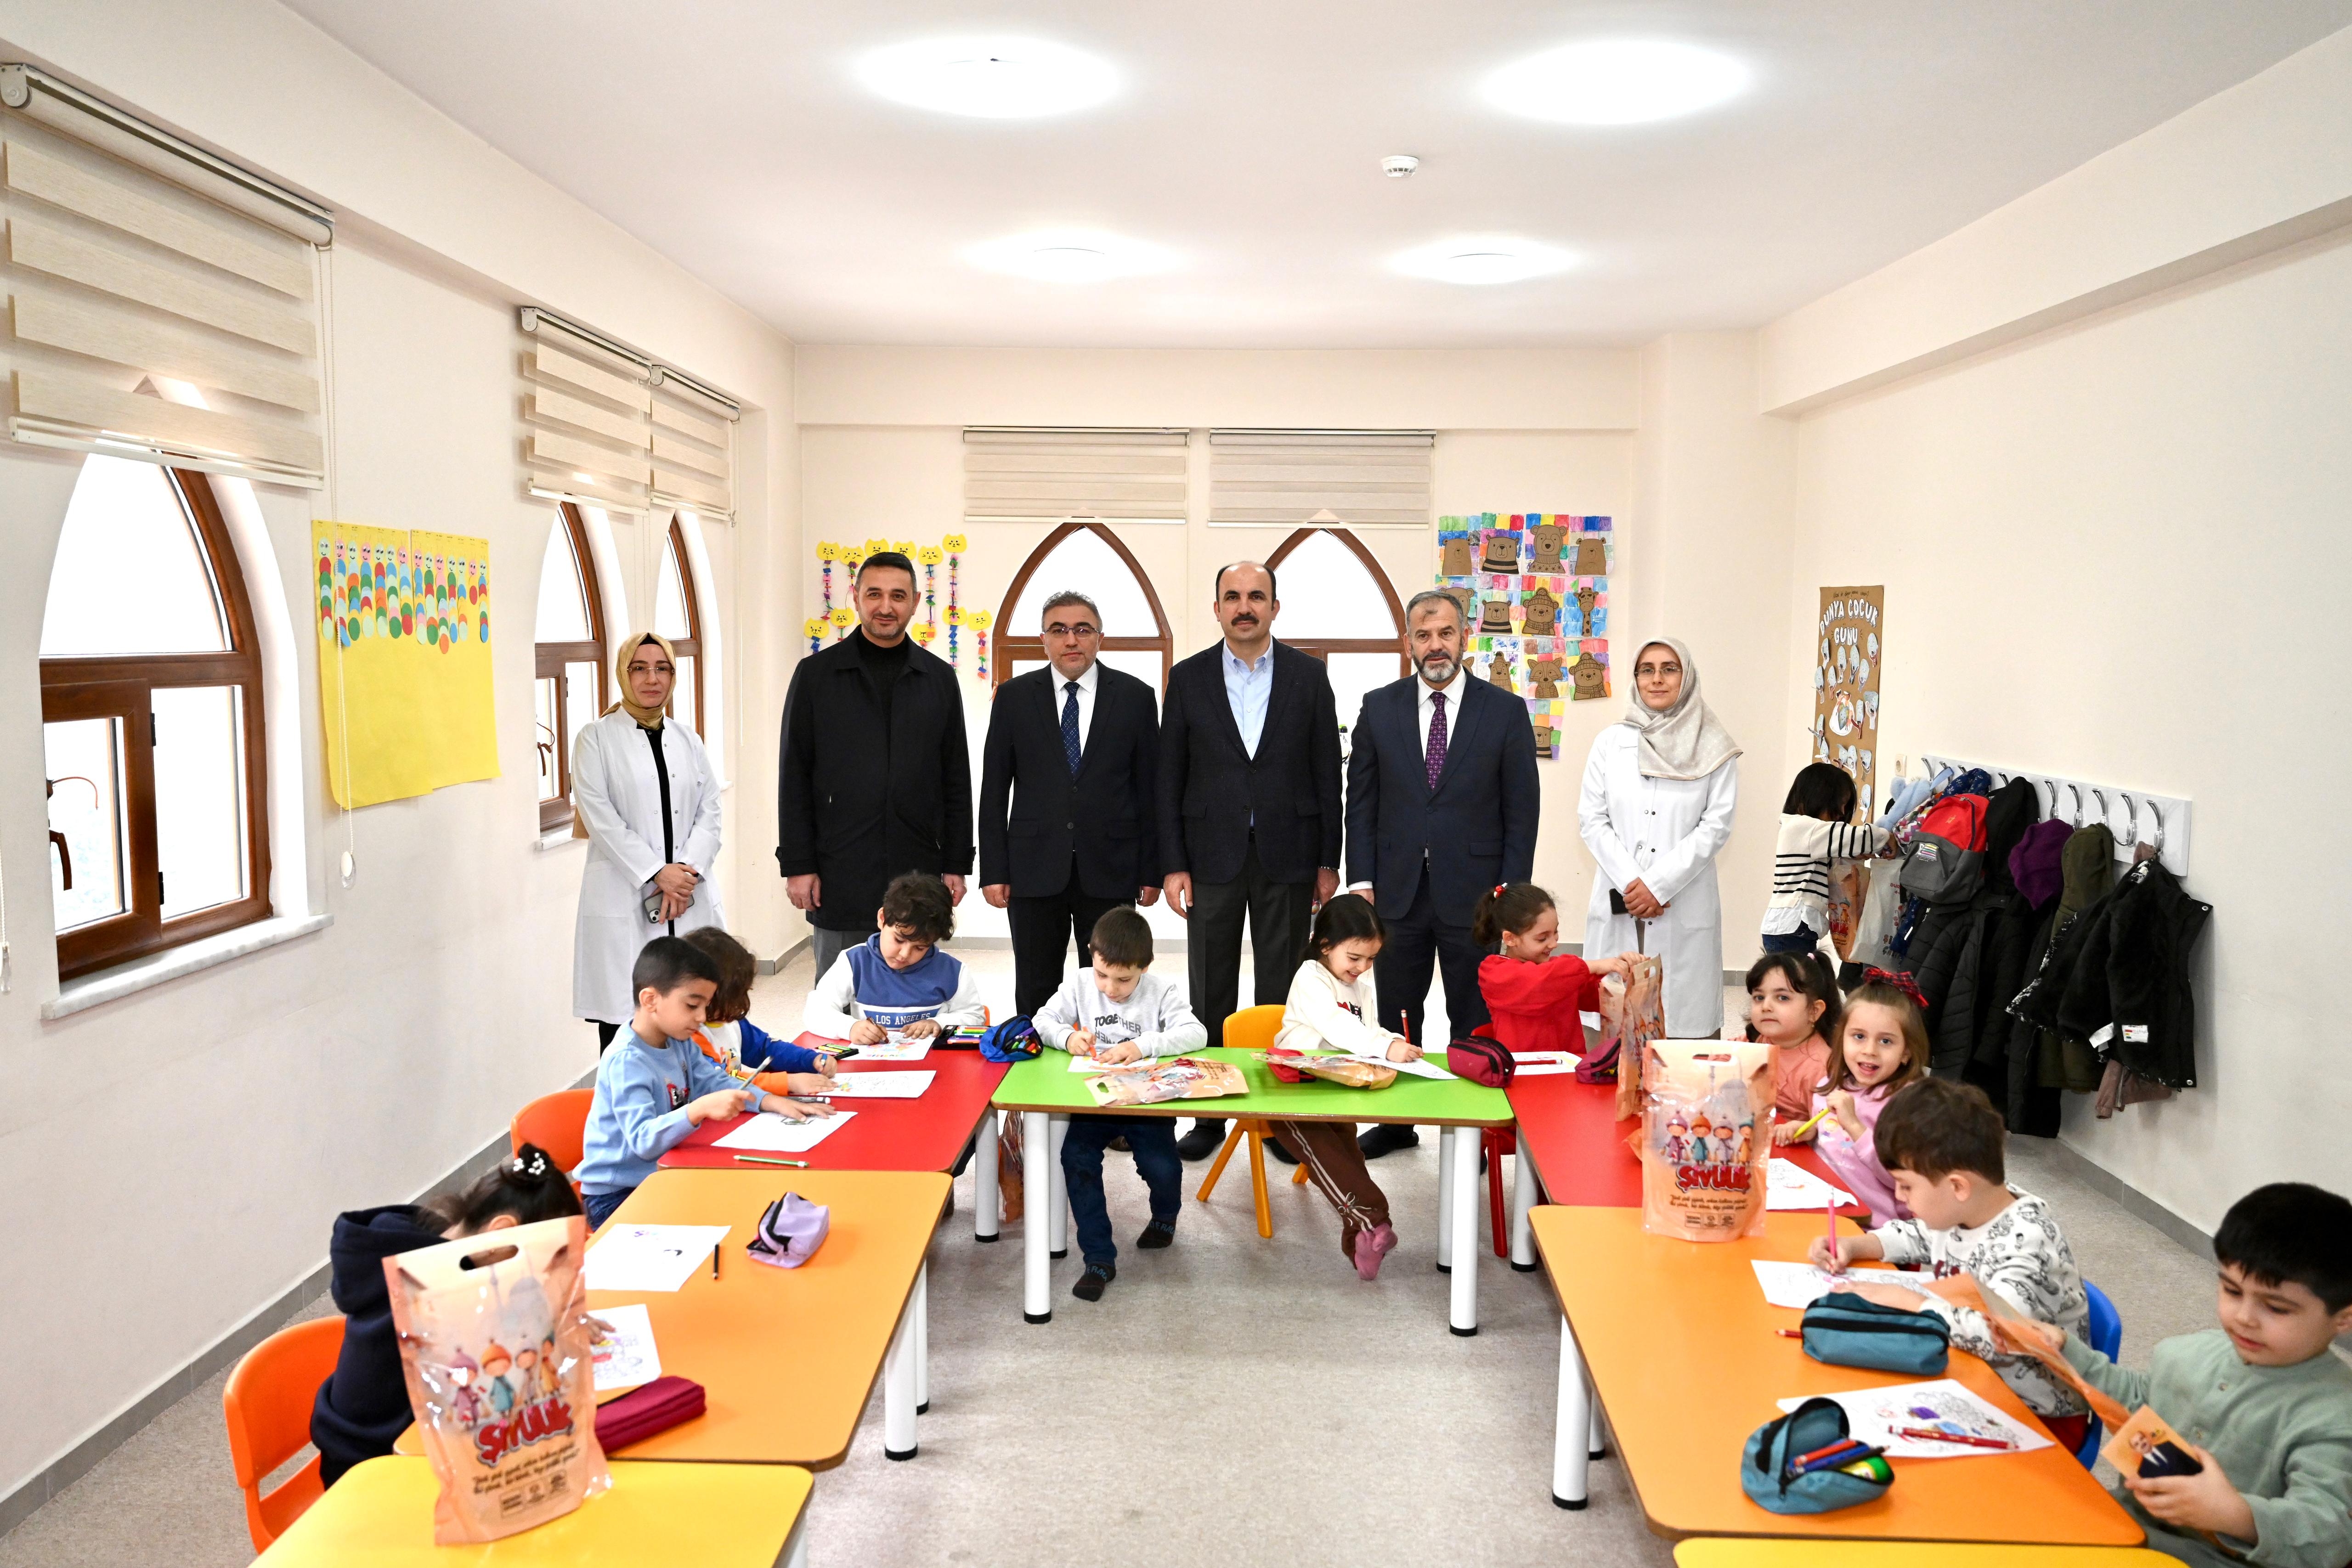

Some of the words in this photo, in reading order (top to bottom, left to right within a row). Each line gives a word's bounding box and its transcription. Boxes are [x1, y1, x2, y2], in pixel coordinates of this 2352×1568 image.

[876, 1015, 891, 1025] LOS
[895, 1013, 931, 1025] ANGELES
[1095, 1013, 1142, 1034] TOGETHER
